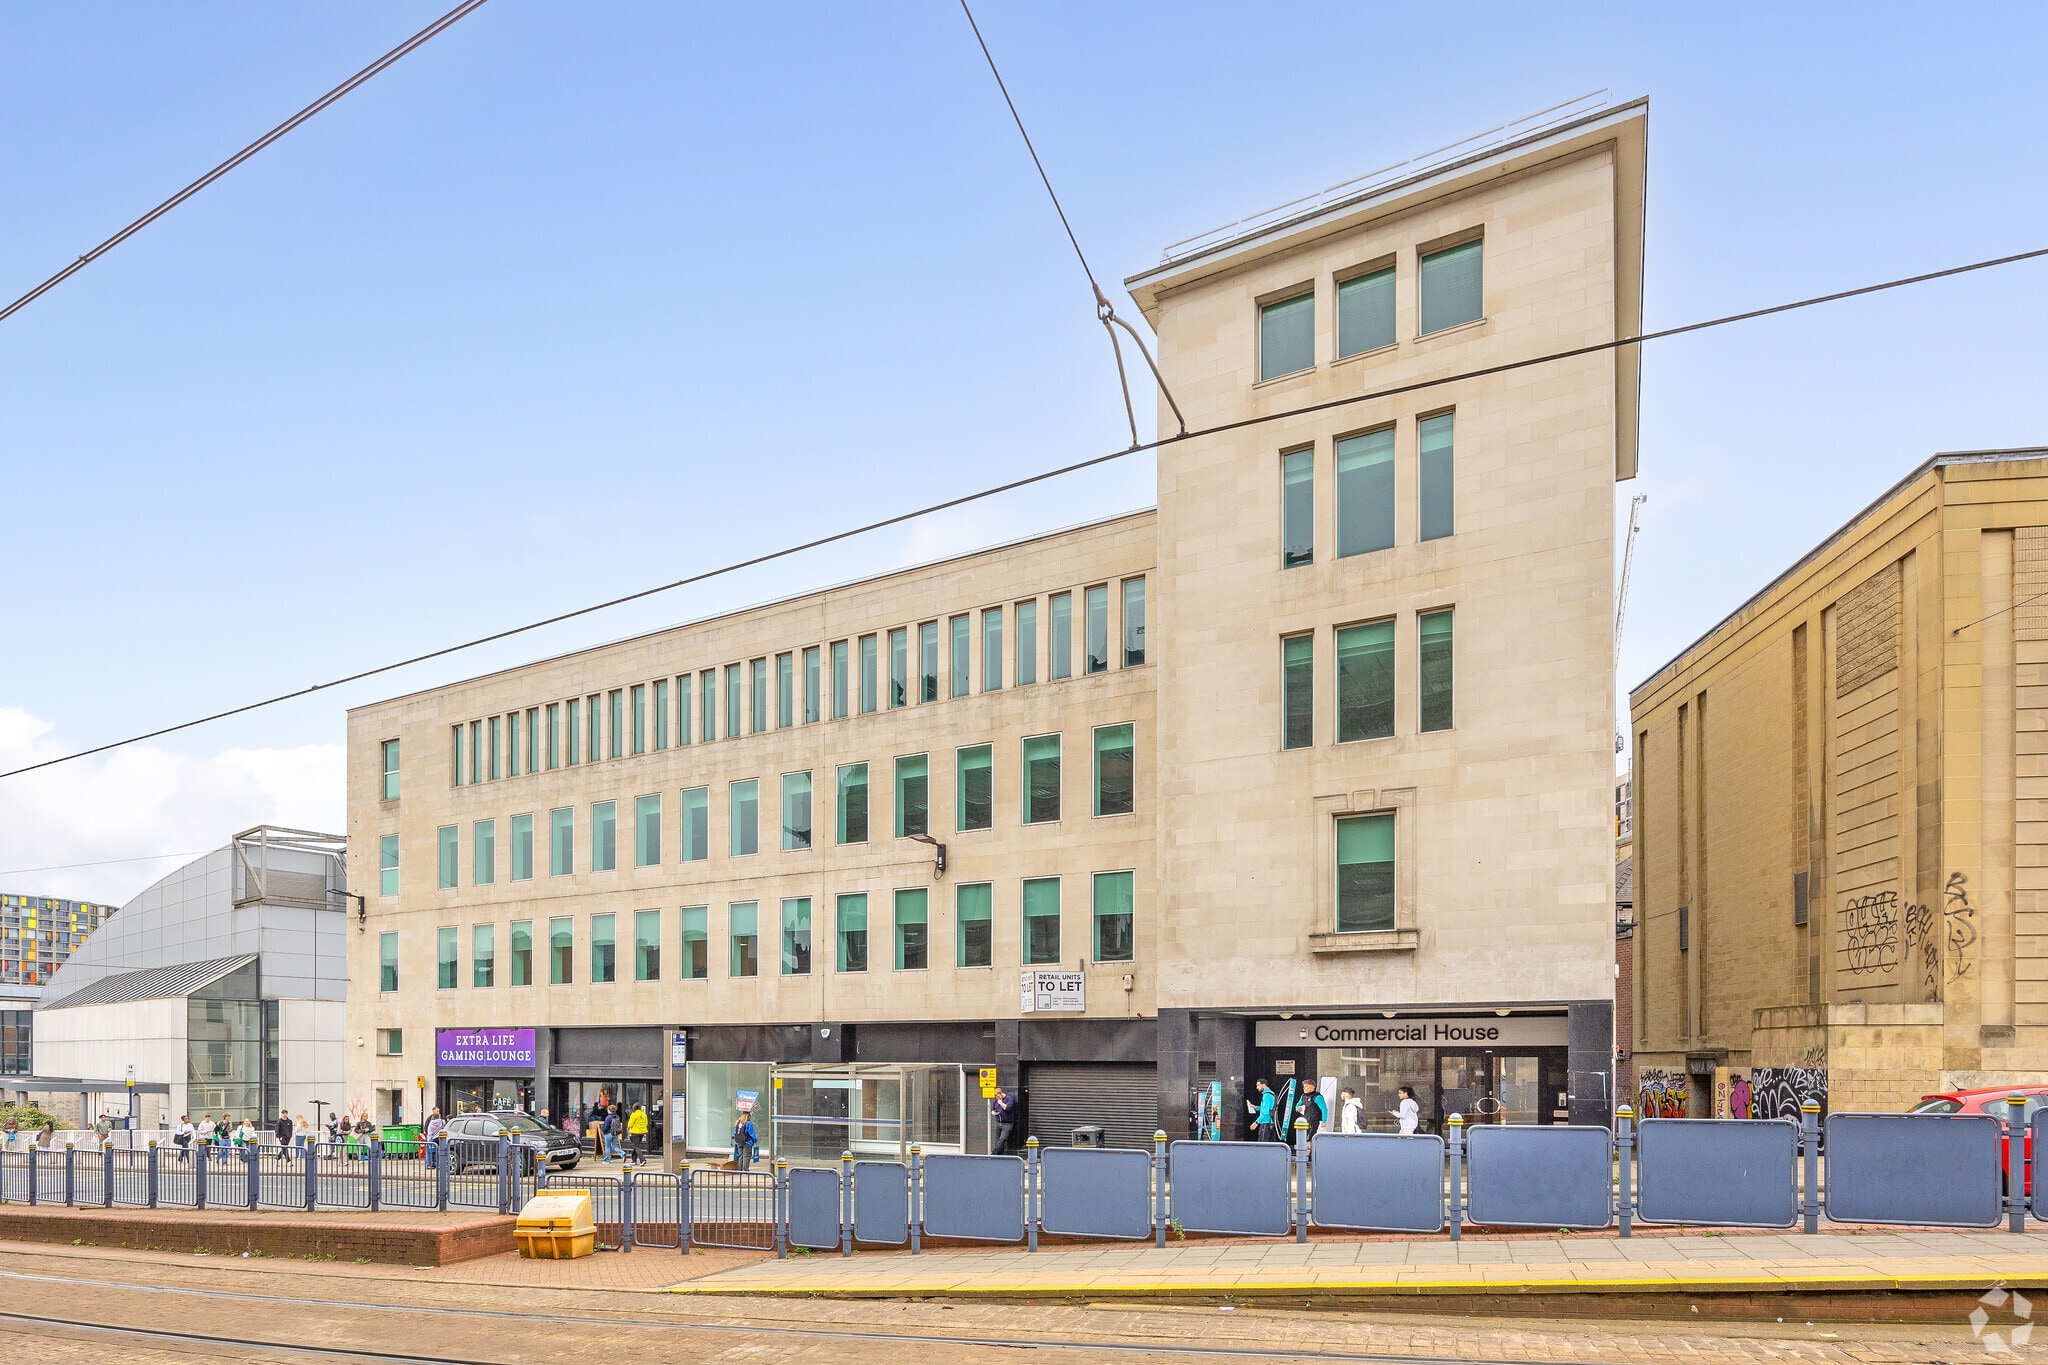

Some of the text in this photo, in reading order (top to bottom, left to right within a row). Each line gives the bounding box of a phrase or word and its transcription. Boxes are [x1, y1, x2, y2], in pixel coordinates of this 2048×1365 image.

[1038, 981, 1082, 991] TO LET
[1315, 1024, 1499, 1041] Commercial House
[456, 1035, 515, 1046] EXTRA LIFE
[441, 1050, 531, 1061] GAMING LOUNGE
[492, 1096, 512, 1106] CAFÉ
